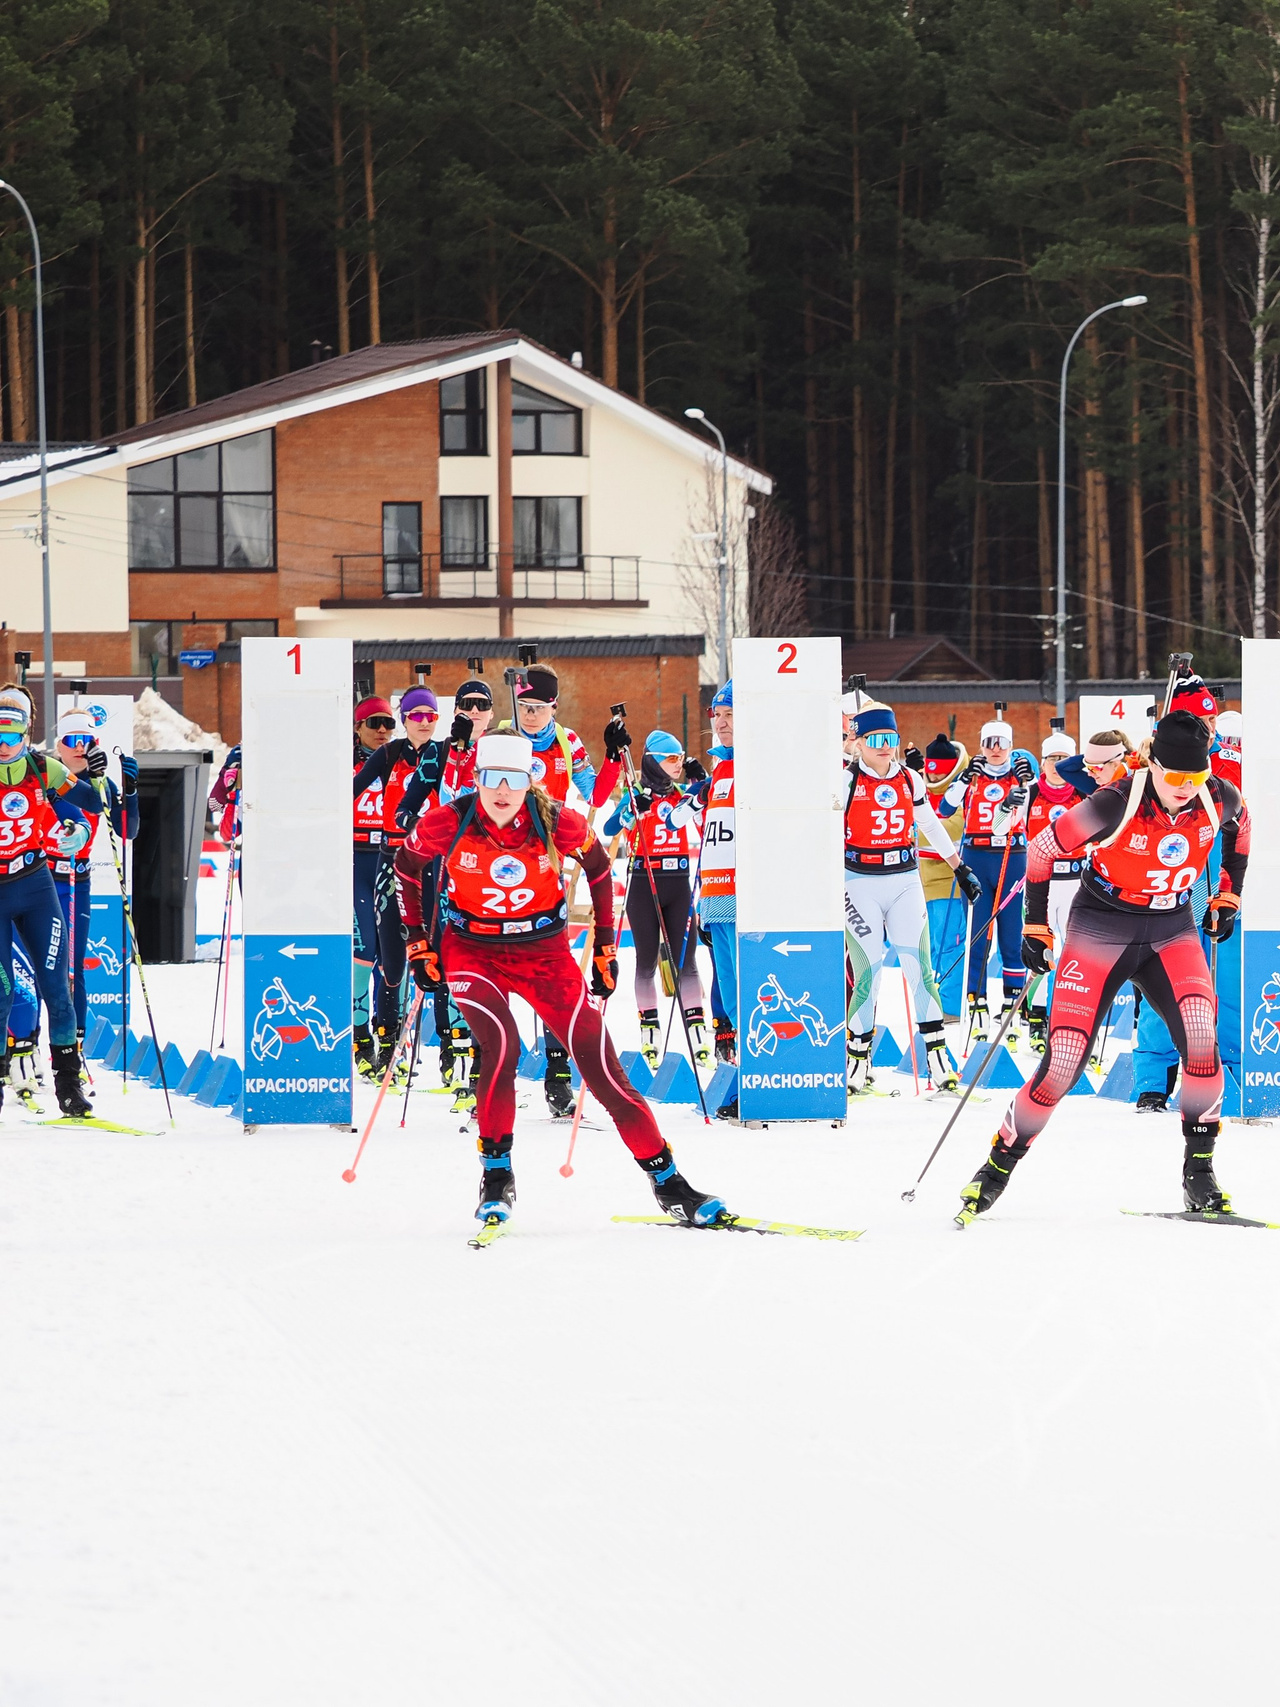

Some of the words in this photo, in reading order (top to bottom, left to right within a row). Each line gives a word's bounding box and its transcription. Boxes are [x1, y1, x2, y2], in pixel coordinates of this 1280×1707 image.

[287, 644, 301, 674] 1
[777, 643, 797, 673] 2
[1110, 699, 1125, 719] 4
[0, 818, 34, 846] 33
[870, 809, 905, 836] 35
[653, 824, 680, 845] 51
[1142, 867, 1197, 893] 30
[481, 887, 535, 913] 29
[1055, 980, 1090, 994] Löffler
[86, 993, 130, 1004] НОЯРСК
[245, 1078, 350, 1093] КРАСНОЯРСК
[741, 1073, 844, 1089] КРАСНОЯРСК
[649, 1157, 664, 1168] 179
